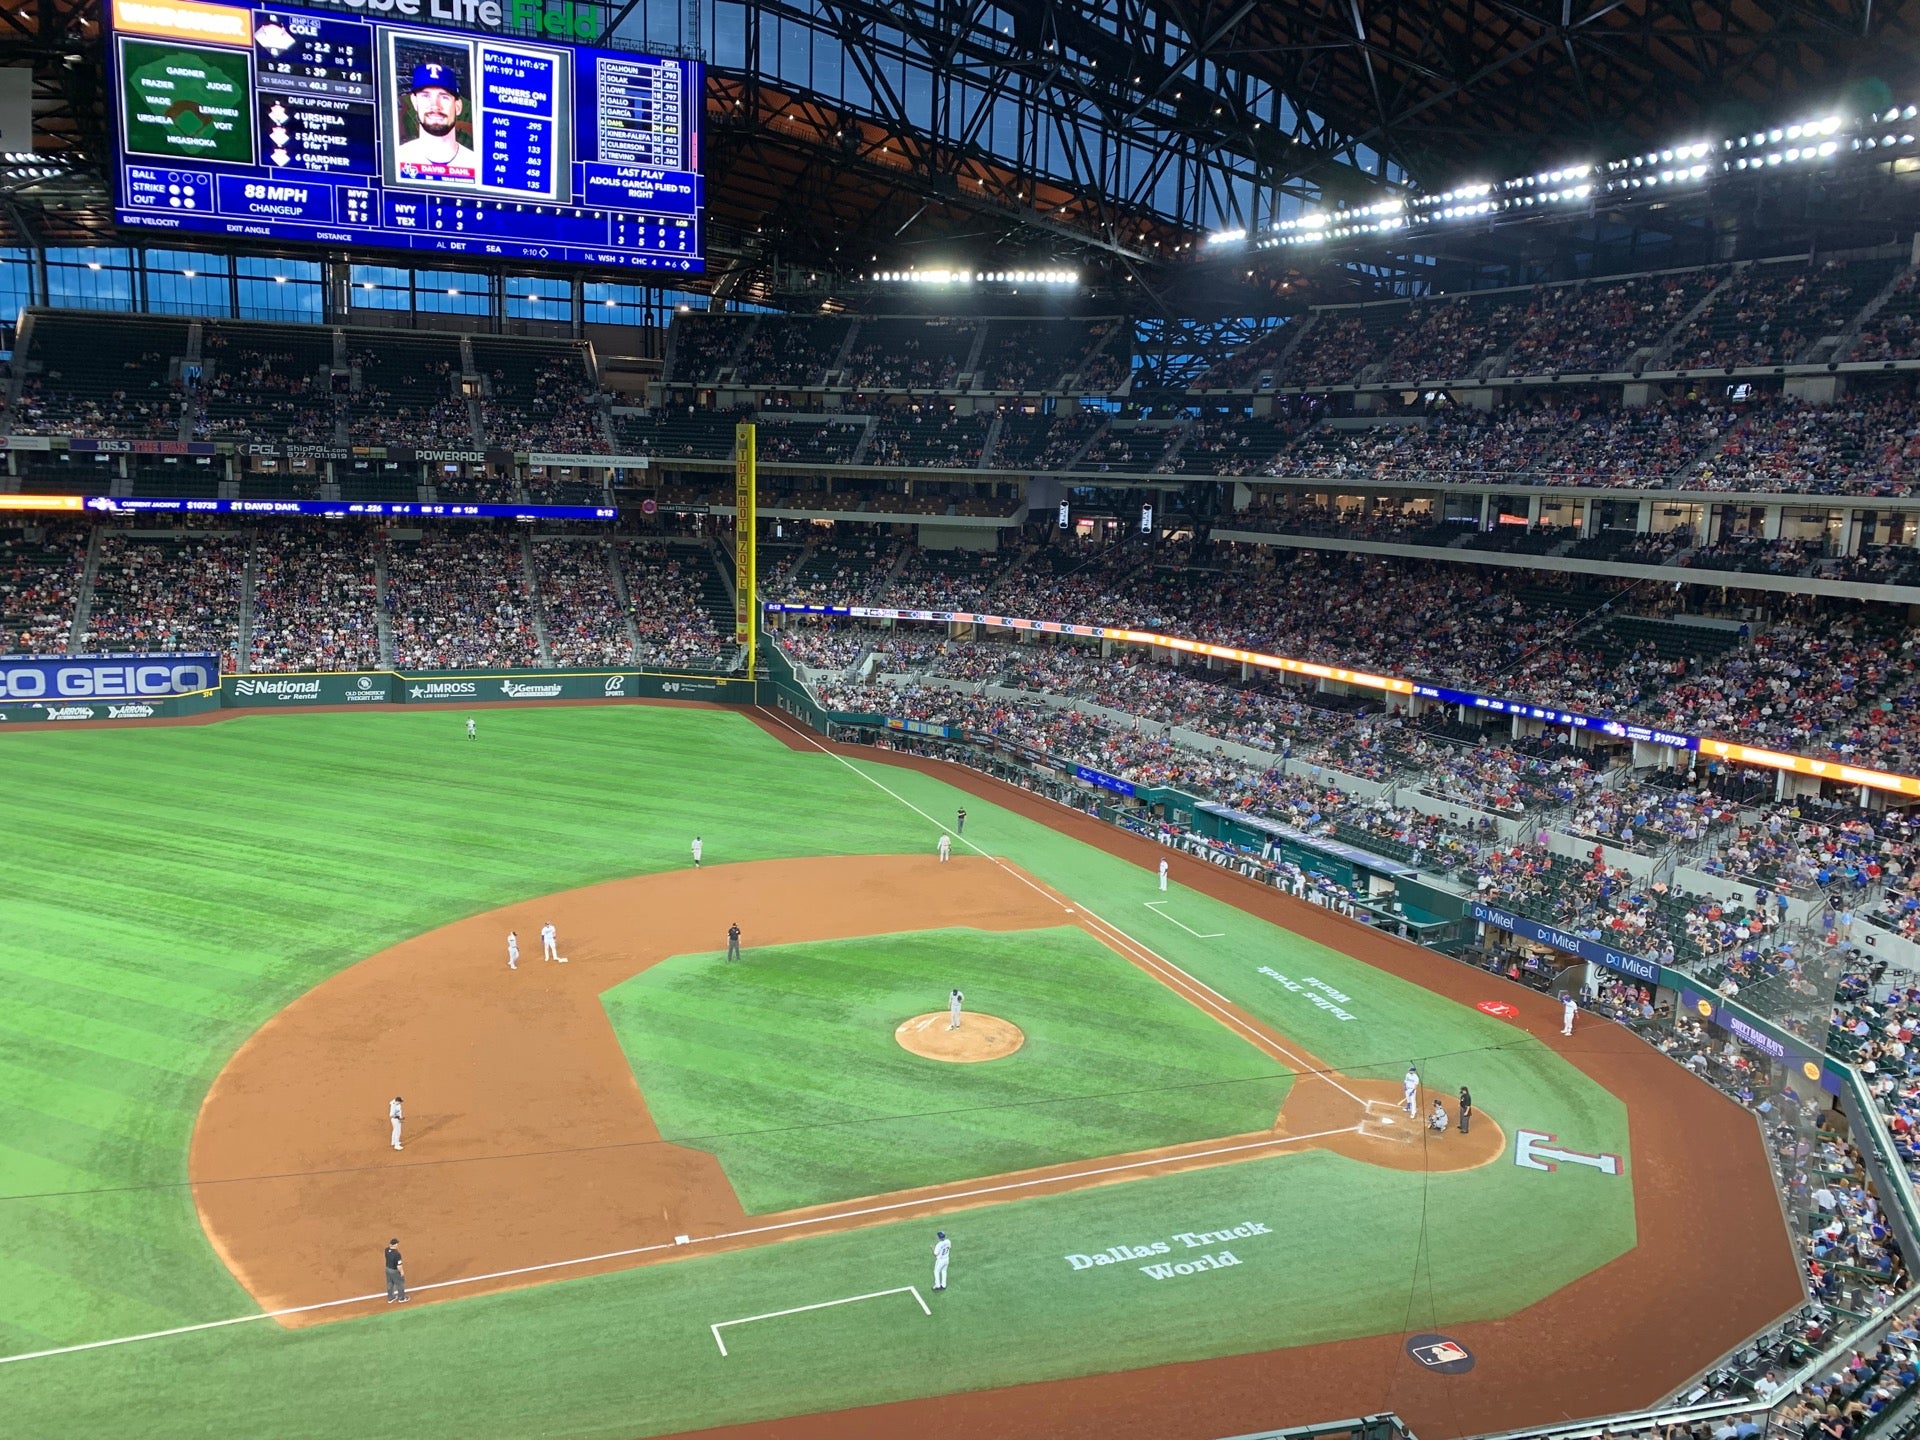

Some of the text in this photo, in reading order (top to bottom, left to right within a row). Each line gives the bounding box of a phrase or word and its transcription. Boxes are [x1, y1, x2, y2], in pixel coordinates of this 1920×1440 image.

[511, 0, 597, 39] Field
[289, 24, 318, 37] COLE
[314, 42, 353, 56] 2.2 5
[302, 53, 353, 67] SO 5 1
[166, 66, 205, 79] GARDNER
[277, 63, 362, 82] 22 39 61
[515, 69, 525, 77] LB
[607, 64, 638, 74] CALHOUN
[141, 78, 175, 90] FRAZIER
[607, 75, 628, 84] SOLAK
[206, 82, 233, 92] JUDGE
[309, 81, 362, 95] 40.5 2.0
[489, 84, 547, 101] RUNNERS ON
[607, 86, 626, 95] LOWE
[145, 96, 171, 106] WADE
[288, 96, 350, 110] DUE UP FOR NYY
[498, 94, 538, 108] (CAREER)
[607, 97, 628, 106] GALLO
[199, 106, 239, 117] LEMAHIEU
[607, 108, 631, 118] GARCÍA
[137, 114, 174, 125] URSHELA
[294, 112, 345, 126] 4 URSHELA
[492, 117, 542, 131] AVG .295
[213, 122, 233, 131] VOIT
[309, 121, 320, 130] for
[302, 131, 348, 146] SÁNCHEZ
[495, 129, 538, 142] HR 21
[608, 130, 651, 141] KINER-FALEFA
[167, 136, 217, 148] HIGASHIOKA
[310, 141, 321, 150] for
[494, 141, 541, 154] RBI 133
[608, 141, 645, 151] CULBERSON
[303, 153, 350, 167] GARDNER
[492, 152, 509, 162] OPS
[608, 152, 635, 161] TREVINO
[311, 162, 322, 170] for
[421, 165, 471, 176] DAVID DAHL
[494, 165, 540, 177] AB 458
[132, 169, 156, 180] BALL
[617, 167, 665, 180] LAST PLAY
[133, 182, 166, 193] STRIKE
[527, 181, 540, 189] 135
[590, 176, 691, 194] ADOLIS GARCÍA FLIED TO
[245, 184, 307, 203] 88 MPH
[348, 189, 368, 199] MVR
[628, 189, 654, 199] RIGHT
[134, 195, 156, 205] OUT
[249, 203, 303, 215] CHANGEUP
[395, 203, 416, 214] NYY
[123, 215, 180, 227] EXIT VELOCITY
[227, 224, 270, 235] EXIT ANGLE
[396, 216, 685, 250] TEX 5 0 2
[317, 232, 352, 241] DISTANCE
[436, 240, 537, 256] AL DET SEA 9:10
[585, 253, 647, 265] NL WSH 3 CHC
[97, 440, 188, 453] 105.3 THE FAN
[249, 444, 280, 455] PGL
[287, 445, 348, 453] ShipPGL.com
[415, 450, 485, 462] POWERADE
[738, 448, 747, 488] THE
[121, 501, 151, 509] CURRENT
[187, 501, 217, 510] $10735
[230, 501, 242, 510] 21
[244, 502, 273, 511] DAVID
[274, 503, 300, 511] DAHL
[365, 505, 382, 513] .226
[403, 505, 410, 513] 4
[738, 496, 747, 533] HOT
[738, 540, 747, 590] ZONE
[56, 665, 207, 697] GEICO
[519, 683, 562, 692] Germania
[203, 690, 213, 698] 374
[58, 707, 87, 715] ARROW
[1422, 688, 1439, 697] DAHL
[1546, 711, 1555, 720] 12
[1574, 716, 1587, 726] 124
[1627, 732, 1651, 742] JACKPOT
[1628, 726, 1652, 736] CURRENT
[1654, 732, 1687, 747] $10735
[1488, 910, 1515, 930] Mitel
[1552, 932, 1580, 953] Mitel
[1622, 957, 1653, 979] Mitel
[1257, 966, 1357, 1021] Dallas Truck
[1302, 977, 1352, 1003] World
[1730, 1018, 1751, 1036] SWEET
[1750, 1029, 1767, 1045] BABY
[1766, 1038, 1784, 1057] RAY'S
[1064, 1221, 1273, 1271] Dallas Truck
[1139, 1250, 1243, 1281] World
